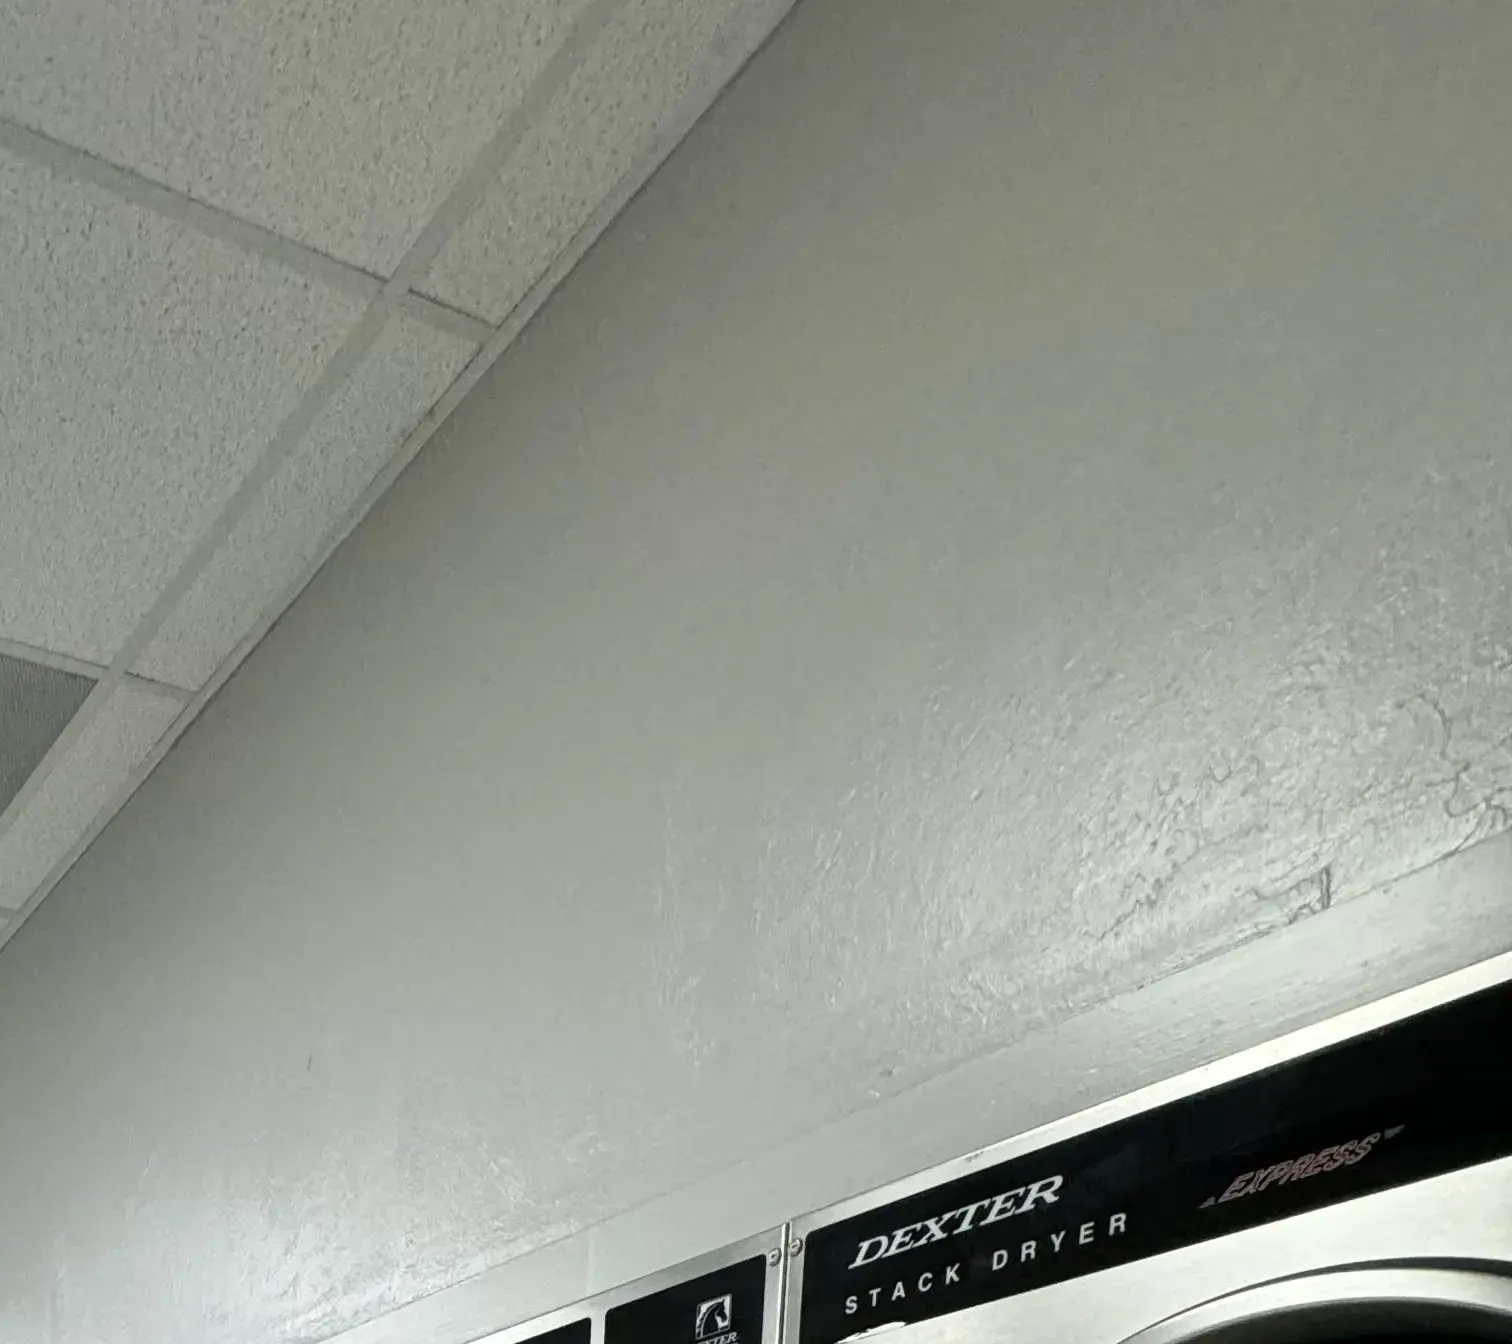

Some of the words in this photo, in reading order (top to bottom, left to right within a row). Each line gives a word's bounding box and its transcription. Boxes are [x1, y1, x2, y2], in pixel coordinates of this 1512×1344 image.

[1218, 1132, 1382, 1203] EXPRESS
[845, 1263, 960, 1314] STACK
[991, 1213, 1128, 1271] DRYER
[848, 1175, 1064, 1270] DEXTER
